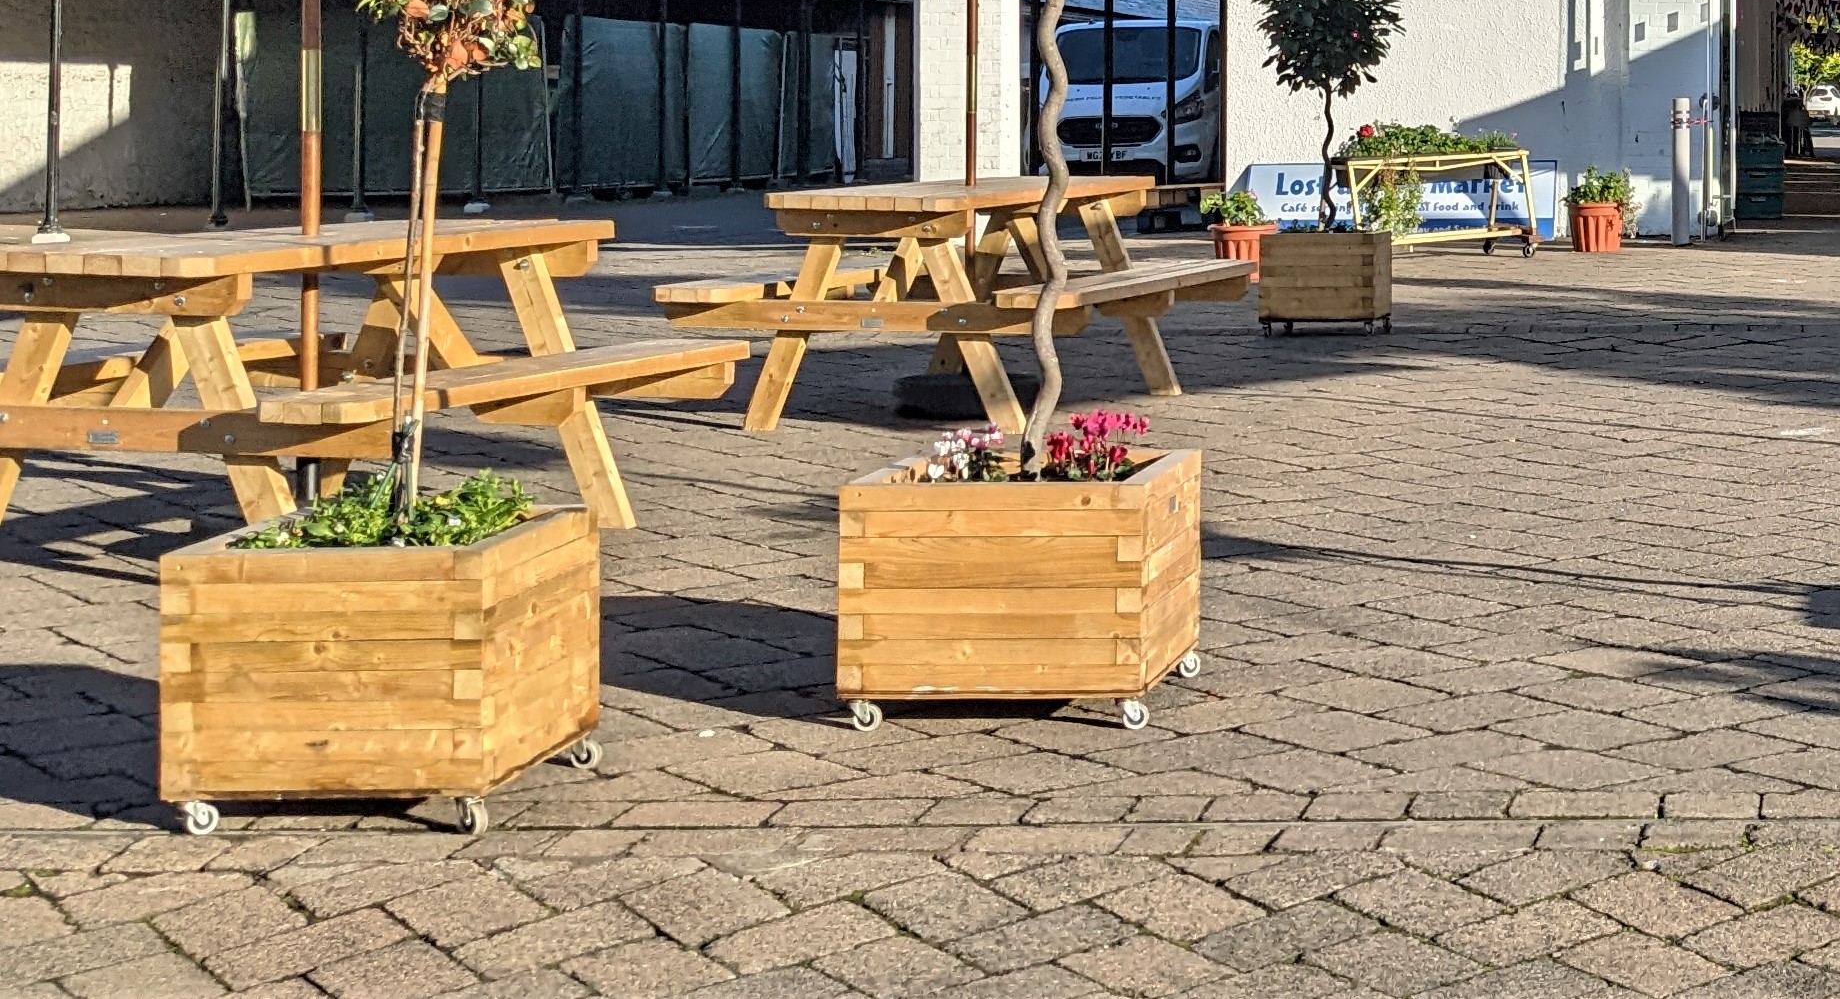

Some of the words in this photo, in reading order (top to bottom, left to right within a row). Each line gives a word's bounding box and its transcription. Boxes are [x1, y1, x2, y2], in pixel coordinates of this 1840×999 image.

[1280, 202, 1307, 213] Café
[1433, 201, 1459, 211] food
[1462, 201, 1485, 211] and
[1488, 201, 1519, 211] rink
